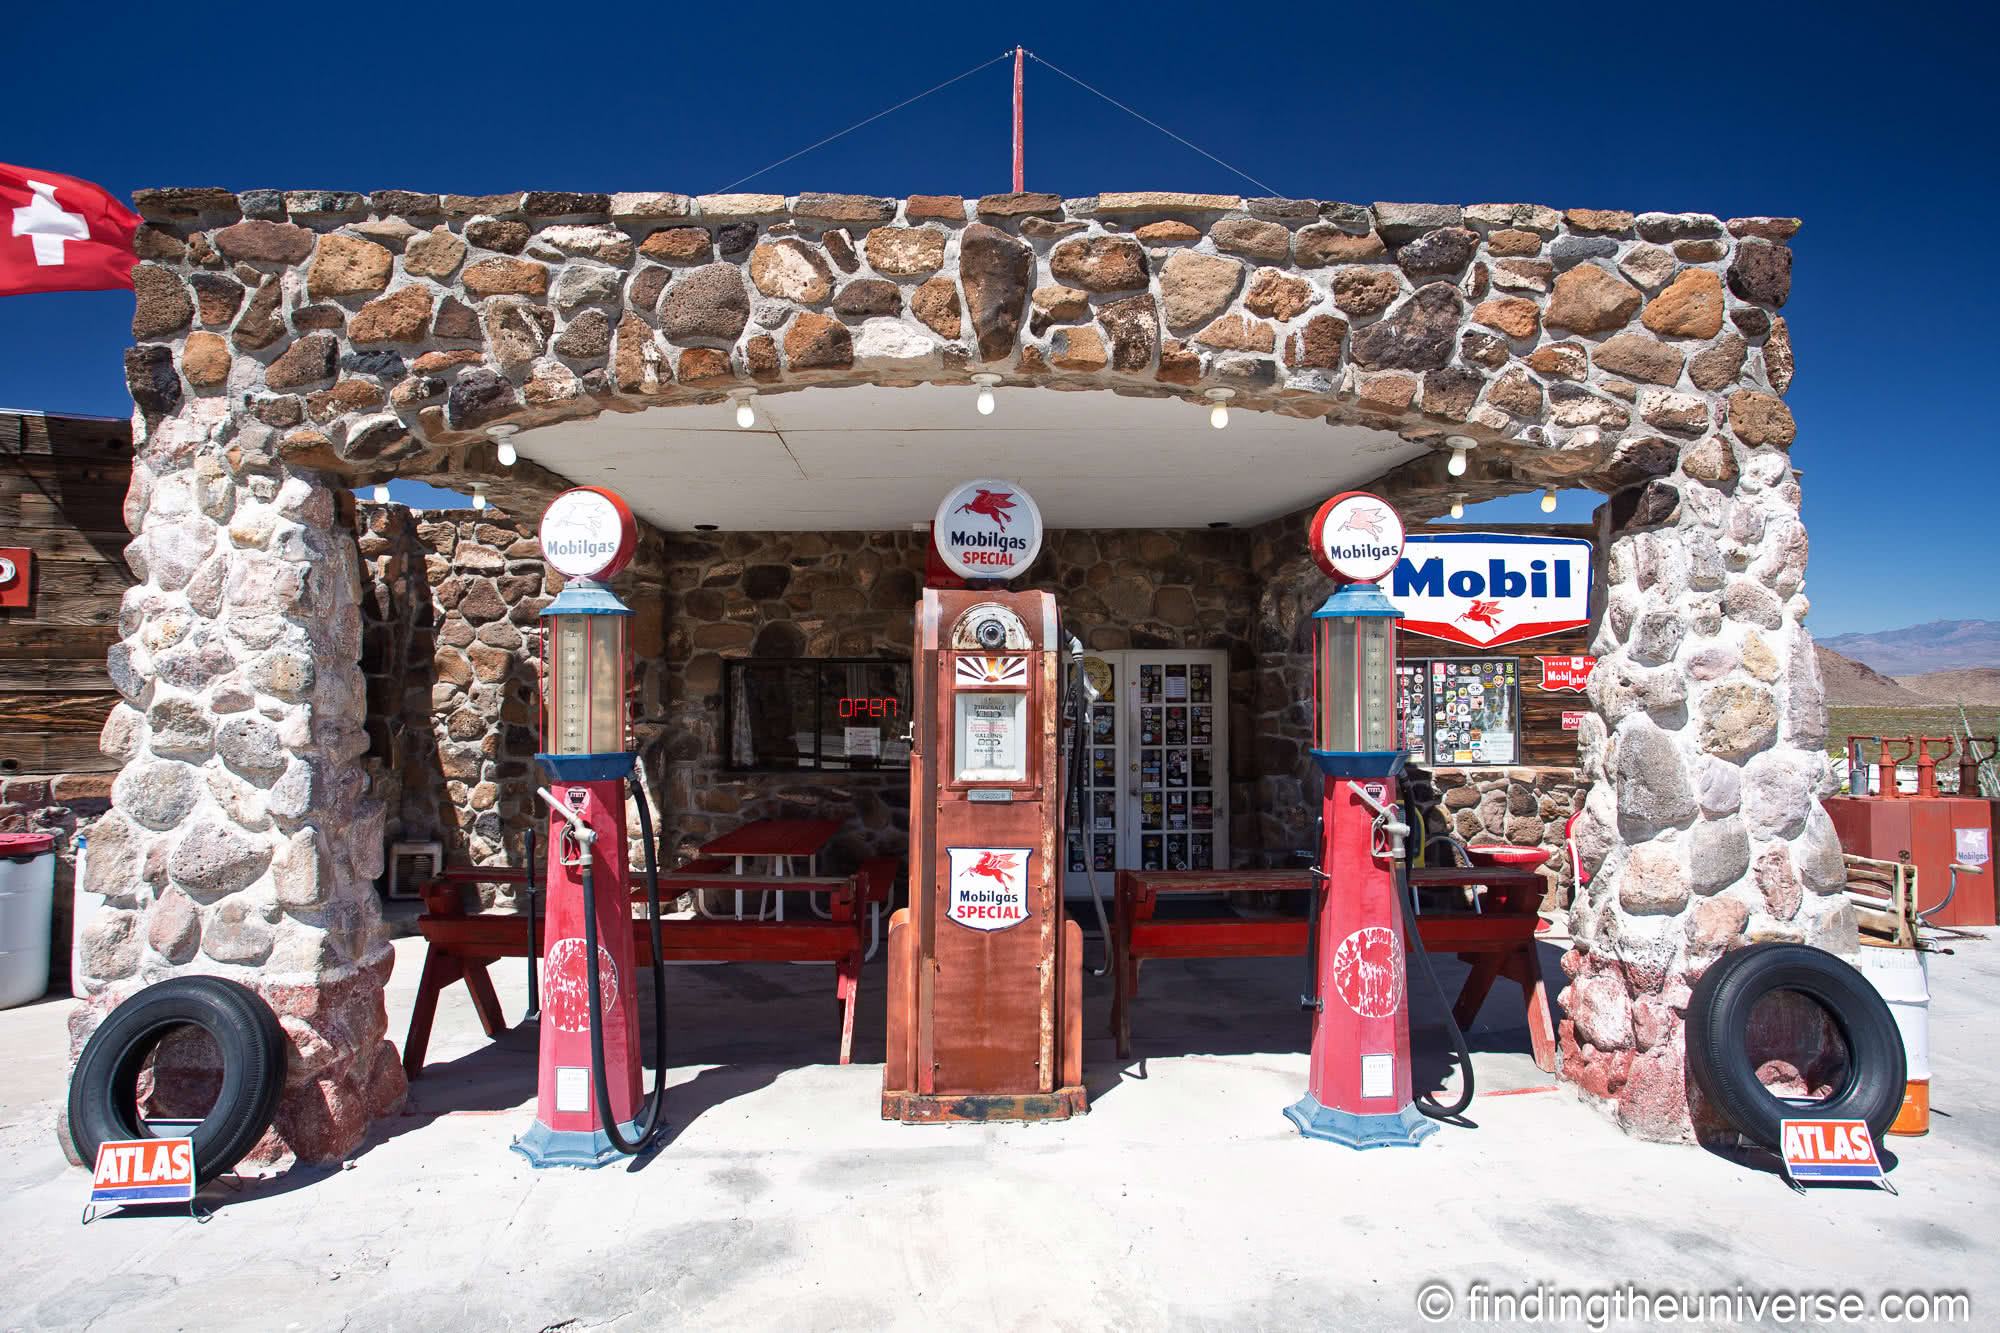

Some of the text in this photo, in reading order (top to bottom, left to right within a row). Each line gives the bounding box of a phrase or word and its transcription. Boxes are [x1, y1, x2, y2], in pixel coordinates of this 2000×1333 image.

[547, 539, 616, 558] Mobilgas
[951, 530, 1026, 553] Mobilgas
[962, 551, 1015, 566] SPECIAL
[1330, 543, 1399, 561] Mobilgas
[1393, 557, 1572, 598] Mobil
[1958, 851, 1987, 862] Mobilgas
[959, 890, 1019, 905] Mobilgas
[957, 905, 1021, 919] SPECIAL
[1785, 1125, 1872, 1161] ATLAS
[95, 1144, 191, 1185] ATLAS
